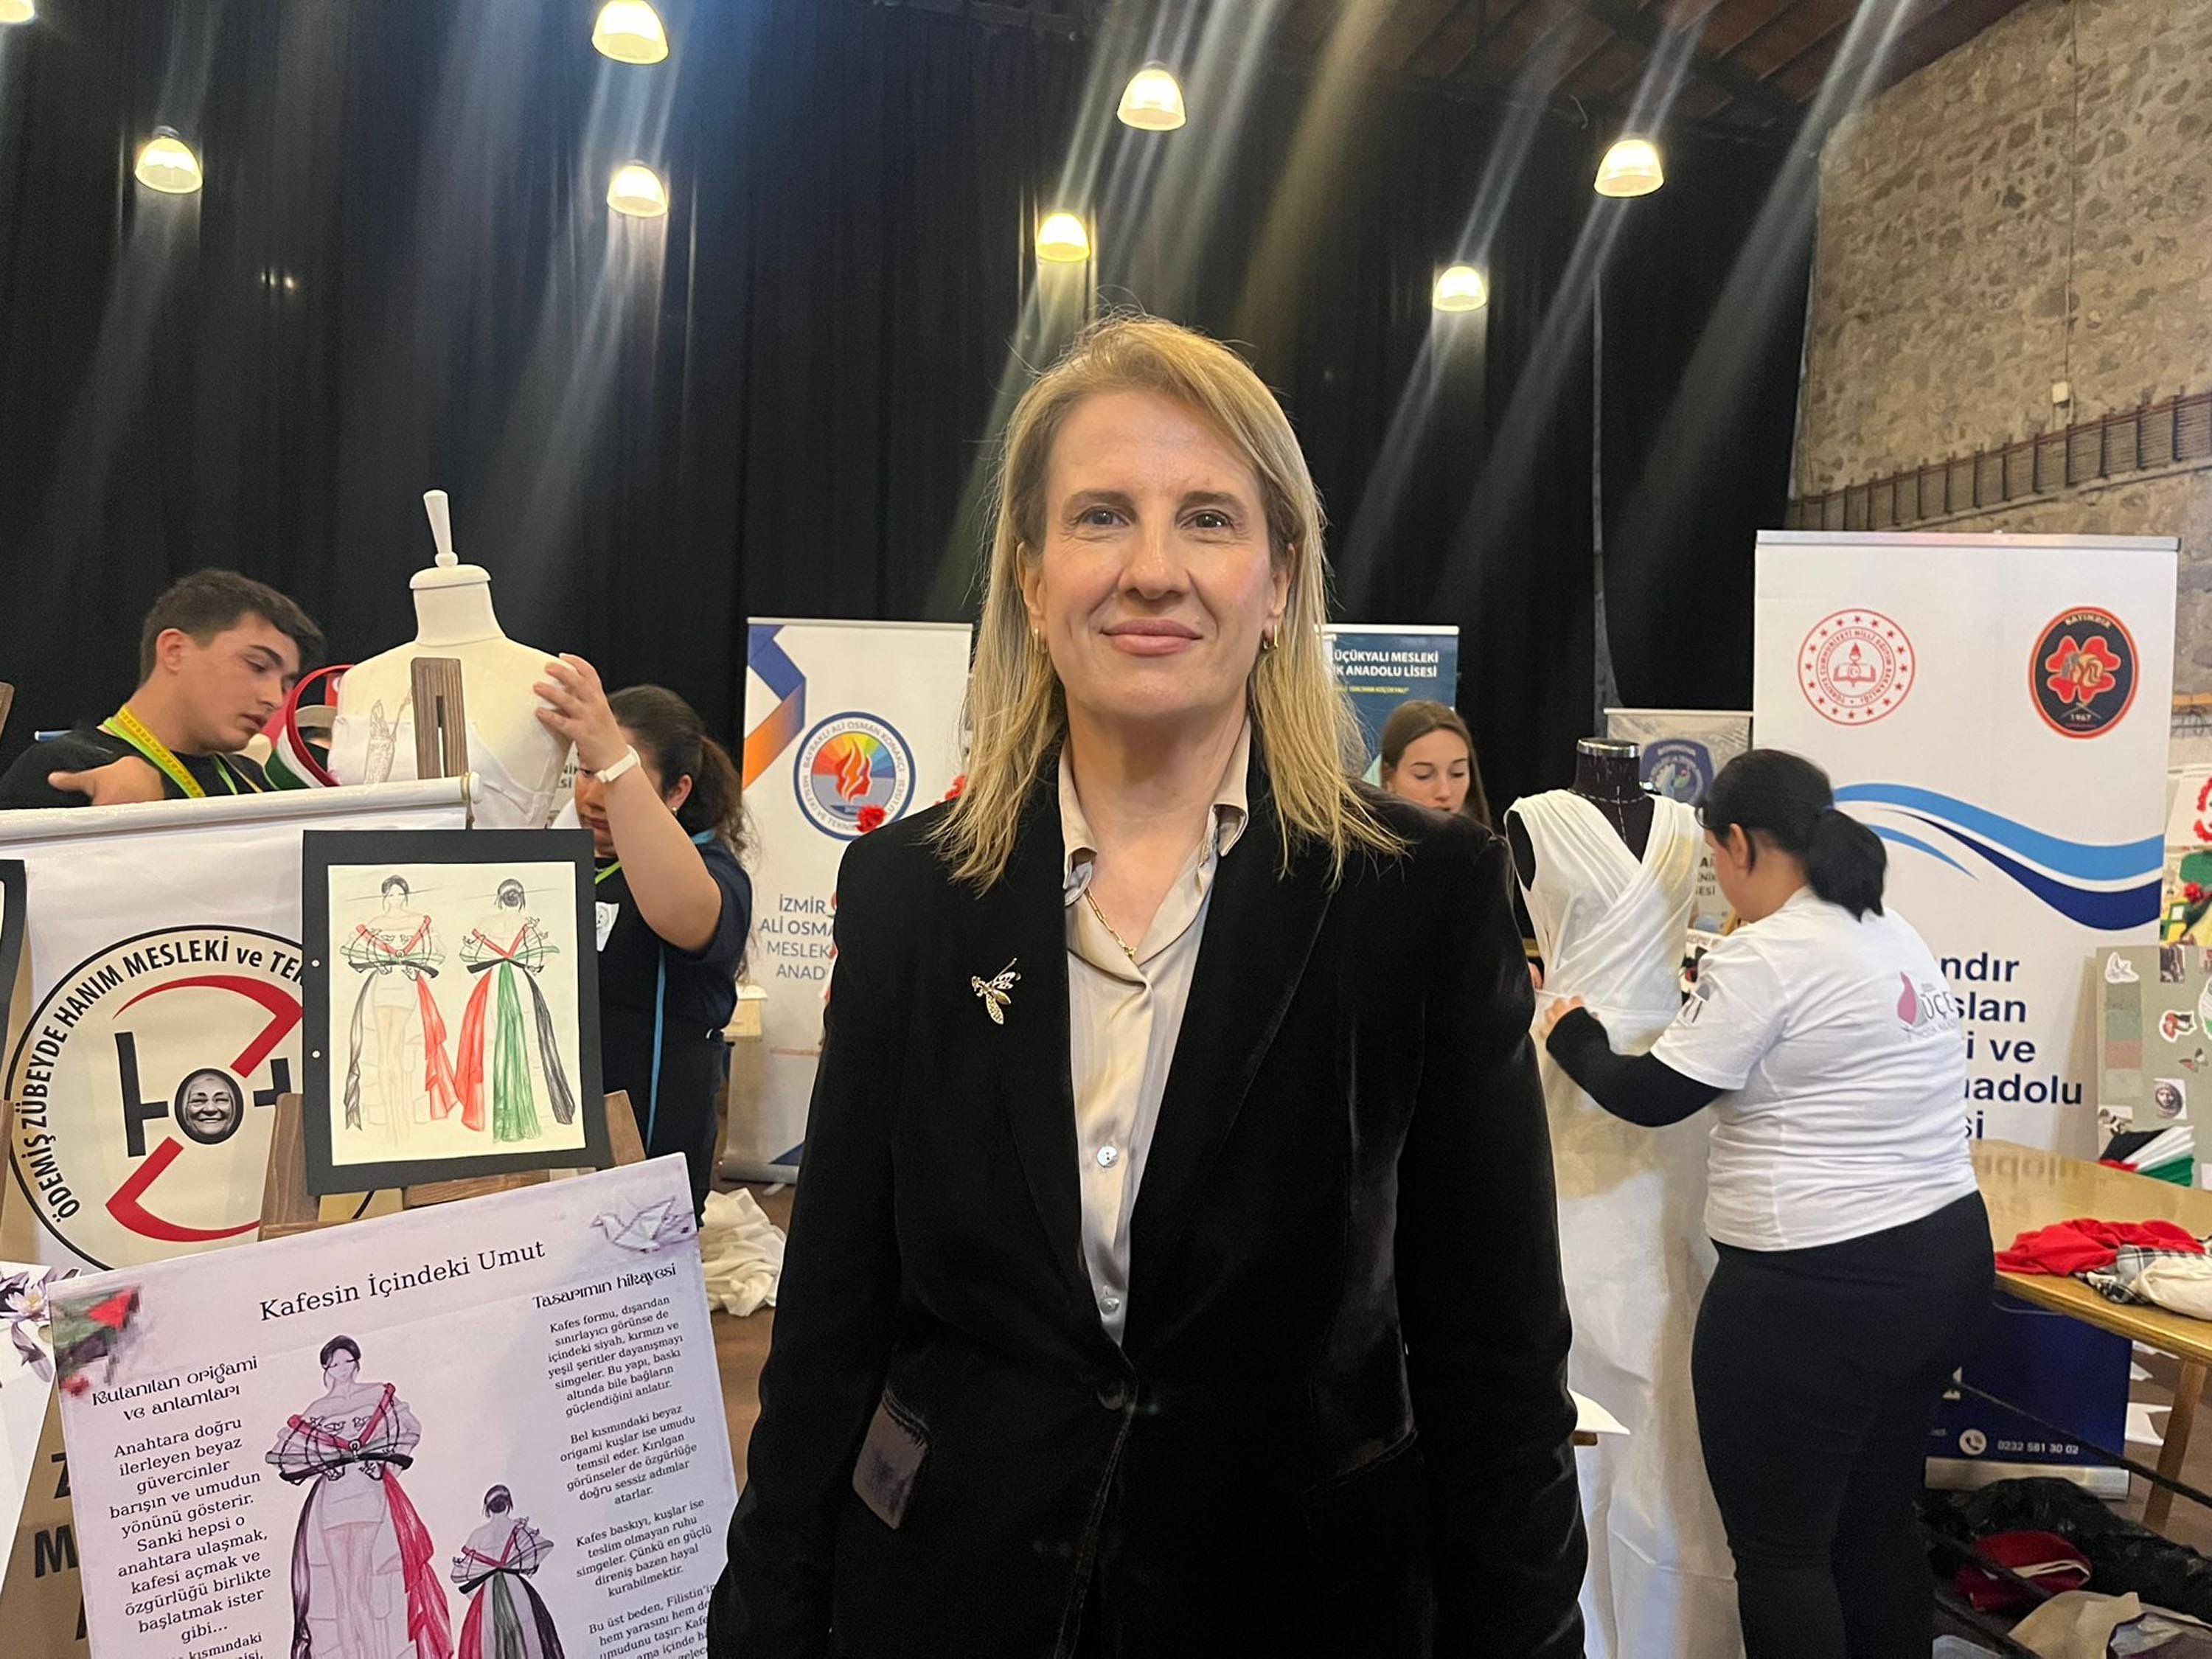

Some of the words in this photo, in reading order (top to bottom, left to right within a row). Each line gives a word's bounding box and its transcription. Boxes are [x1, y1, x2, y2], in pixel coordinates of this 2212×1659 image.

[1333, 649, 1389, 663] ÜÇÜKYALI
[1391, 651, 1438, 663] MESLEKİ
[1346, 665, 1401, 676] ANADOLU
[1404, 665, 1437, 678] LİSESİ
[779, 894, 826, 914] İZMİR
[760, 916, 783, 933] ALİ
[123, 936, 229, 978] MESLEKİ
[237, 947, 262, 967] ve
[768, 940, 830, 958] MESLEK
[776, 964, 828, 980] ANAD
[54, 964, 124, 1027] HANIM
[1989, 1039, 2036, 1062] ve
[15, 1026, 68, 1130] ZÜBEYDE
[21, 1134, 80, 1222] ÖDEMİŞ
[260, 1284, 361, 1321] Kafesin
[368, 1257, 470, 1298] İçindeki
[477, 1241, 546, 1270] Umut
[532, 1281, 612, 1309] Tasarımın
[618, 1263, 676, 1288] hikayesi
[550, 1318, 580, 1333] Kafes
[584, 1310, 619, 1325] formu,
[622, 1297, 670, 1315] dışarıdan
[555, 1326, 608, 1346] sınırlayıcı
[611, 1315, 653, 1334] görünse
[656, 1310, 669, 1320] de
[548, 1362, 573, 1380] yeşil
[577, 1351, 616, 1371] şeritler
[619, 1335, 683, 1359] dayanışmayı
[549, 1343, 591, 1363] içindeki
[594, 1335, 625, 1351] siyah,
[628, 1326, 664, 1341] kırmızı
[667, 1322, 680, 1330] ve
[92, 1377, 180, 1406] Kulanılan
[187, 1356, 257, 1384] origami
[555, 1371, 605, 1390] simgeler.
[608, 1365, 622, 1376] Bu
[625, 1358, 650, 1374] yapı,
[653, 1349, 681, 1363] baskı
[567, 1384, 605, 1401] altında
[608, 1378, 627, 1390] bile
[630, 1366, 673, 1383] bağların
[123, 1408, 145, 1421] ve
[152, 1385, 240, 1415] anlamları
[566, 1389, 633, 1418] güçlendiğini
[636, 1380, 672, 1397] anlatır.
[114, 1432, 189, 1458] Anahtara
[195, 1419, 242, 1439] doğru
[560, 1442, 602, 1462] origami
[606, 1431, 639, 1449] kuşlar
[642, 1427, 657, 1438] ise
[660, 1416, 695, 1432] umudu
[571, 1431, 588, 1444] Bel
[591, 1416, 650, 1438] kısmındaki
[653, 1405, 682, 1421] beyaz
[119, 1452, 190, 1476] ilerleyen
[195, 1437, 242, 1458] beyaz
[577, 1455, 611, 1472] temsil
[613, 1447, 640, 1461] eder.
[643, 1433, 684, 1452] Kırılgan
[1997, 1440, 2023, 1451] 0232
[2050, 1444, 2062, 1453] 30
[2065, 1445, 2079, 1455] 02
[136, 1459, 230, 1495] güvercinler
[567, 1465, 626, 1492] görünseler
[629, 1460, 642, 1471] de
[645, 1443, 697, 1466] özgürlüğe
[580, 1485, 611, 1500] doğru
[615, 1473, 647, 1489] sessiz
[650, 1460, 690, 1479] adımlar
[109, 1497, 166, 1519] barışın
[172, 1491, 189, 1503] ve
[195, 1472, 261, 1497] umudun
[614, 1486, 653, 1504] atarlar.
[122, 1512, 182, 1539] yönünü
[187, 1493, 254, 1522] gösterir.
[137, 1530, 182, 1552] Sanki
[188, 1517, 231, 1539] hepsi
[236, 1516, 245, 1526] o
[576, 1533, 607, 1547] Kafes
[610, 1518, 651, 1536] baskıyı,
[654, 1506, 687, 1522] kuşlar
[689, 1499, 704, 1510] ise
[118, 1550, 191, 1577] anahtara
[197, 1529, 268, 1557] ulaşmak,
[577, 1557, 626, 1577] simgeler.
[630, 1541, 664, 1560] Çünkü
[667, 1537, 681, 1546] en
[683, 1525, 712, 1543] güçlü
[588, 1541, 622, 1558] teslim
[625, 1526, 669, 1545] olmayan
[672, 1516, 697, 1530] ruhu
[131, 1571, 180, 1594] kafesi
[185, 1556, 237, 1580] açmak
[242, 1551, 260, 1563] ve
[595, 1568, 633, 1586] direniş
[636, 1555, 667, 1572] bazen
[671, 1543, 699, 1562] hayal
[608, 1565, 684, 1597] kurabilmektir.
[125, 1584, 208, 1616] özgürlüğü
[214, 1568, 271, 1593] birlikte
[139, 1601, 223, 1633] başlatmak
[228, 1589, 264, 1608] ister
[181, 1621, 228, 1644] gibi...
[589, 1623, 604, 1634] Bu
[608, 1614, 625, 1627] üst
[627, 1604, 664, 1620] beden,
[599, 1630, 623, 1646] hem
[626, 1617, 669, 1638] yarasını
[672, 1606, 695, 1621] hem
[189, 1632, 262, 1659] kısmındaki
[600, 1638, 651, 1659] umudunu
[664, 1636, 695, 1655] içinde
